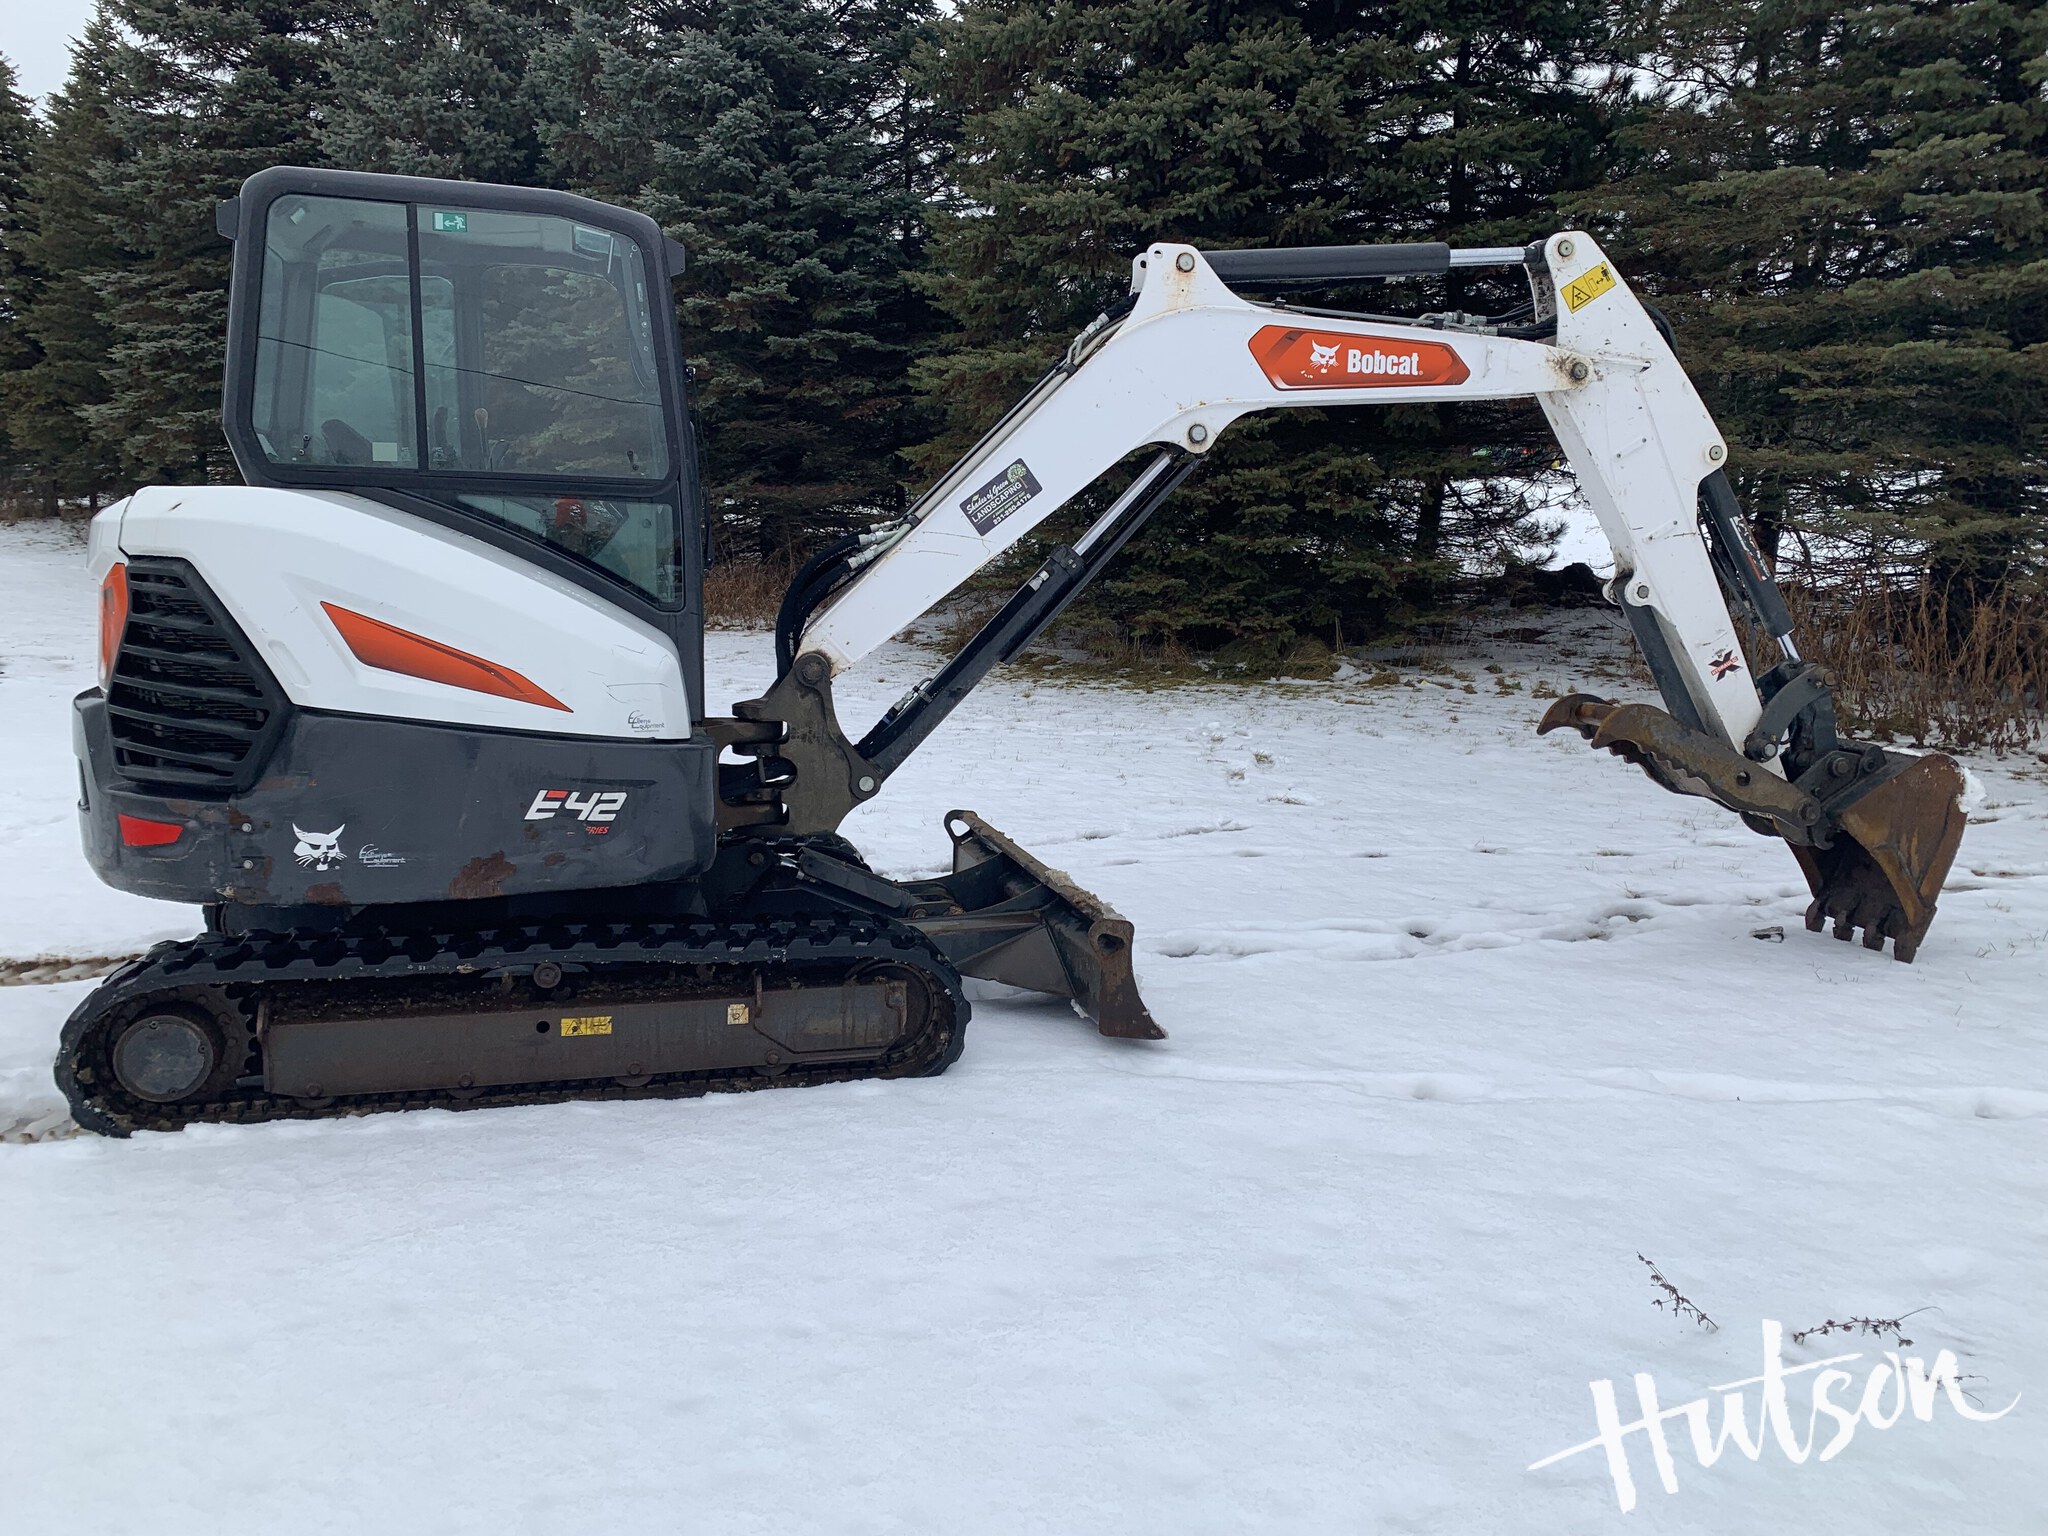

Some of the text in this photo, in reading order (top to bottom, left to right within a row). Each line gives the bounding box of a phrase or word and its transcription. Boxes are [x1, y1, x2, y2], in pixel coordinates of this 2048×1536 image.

[1347, 348, 1418, 376] Bobcat
[966, 495, 988, 514] Shades
[992, 480, 1009, 496] Green
[971, 481, 1022, 522] LANDSCAPING
[524, 789, 628, 822] E42
